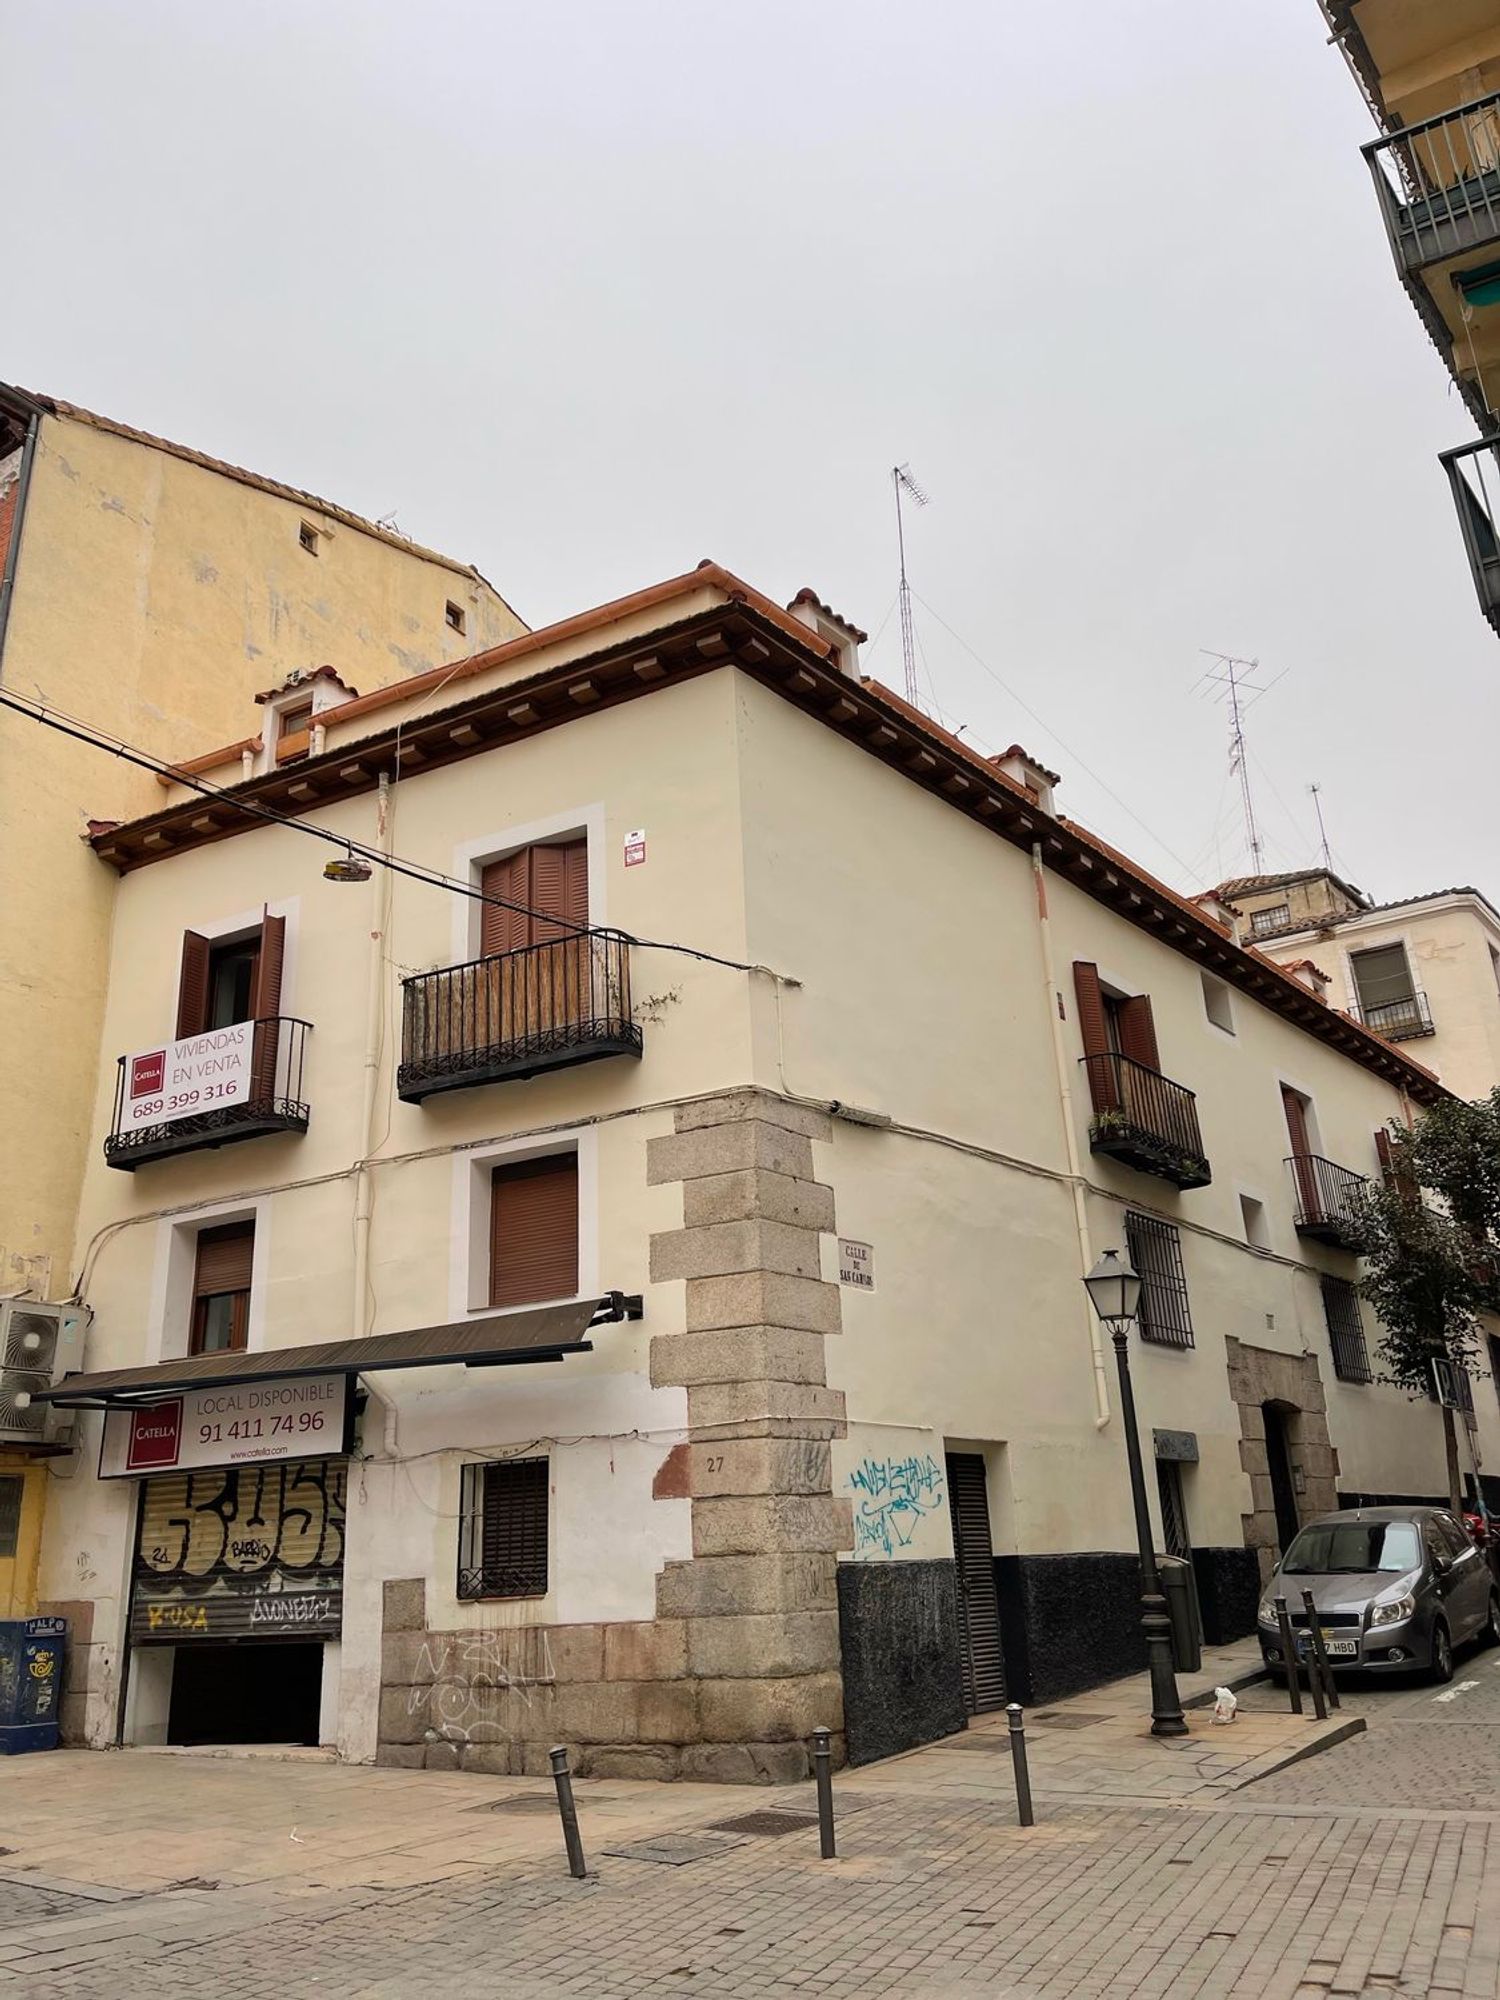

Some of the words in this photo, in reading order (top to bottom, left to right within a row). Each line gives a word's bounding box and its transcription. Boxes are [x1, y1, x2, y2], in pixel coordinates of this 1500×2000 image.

[174, 1028, 245, 1060] VIVIENDAS
[134, 1068, 160, 1081] CATELLA
[173, 1066, 192, 1084] EN
[196, 1054, 241, 1077] VENTA
[133, 1099, 164, 1119] 689
[167, 1090, 200, 1111] 399
[203, 1080, 237, 1101] 316
[197, 1398, 243, 1416] LOCAL
[249, 1382, 335, 1409] DISPONIBLE
[136, 1426, 175, 1440] CATELLA
[200, 1423, 223, 1444] 91
[227, 1418, 264, 1440] 411
[269, 1414, 294, 1436] 74
[298, 1411, 325, 1433] 96
[230, 1445, 288, 1460] www.catella.com
[706, 1456, 724, 1473] 27
